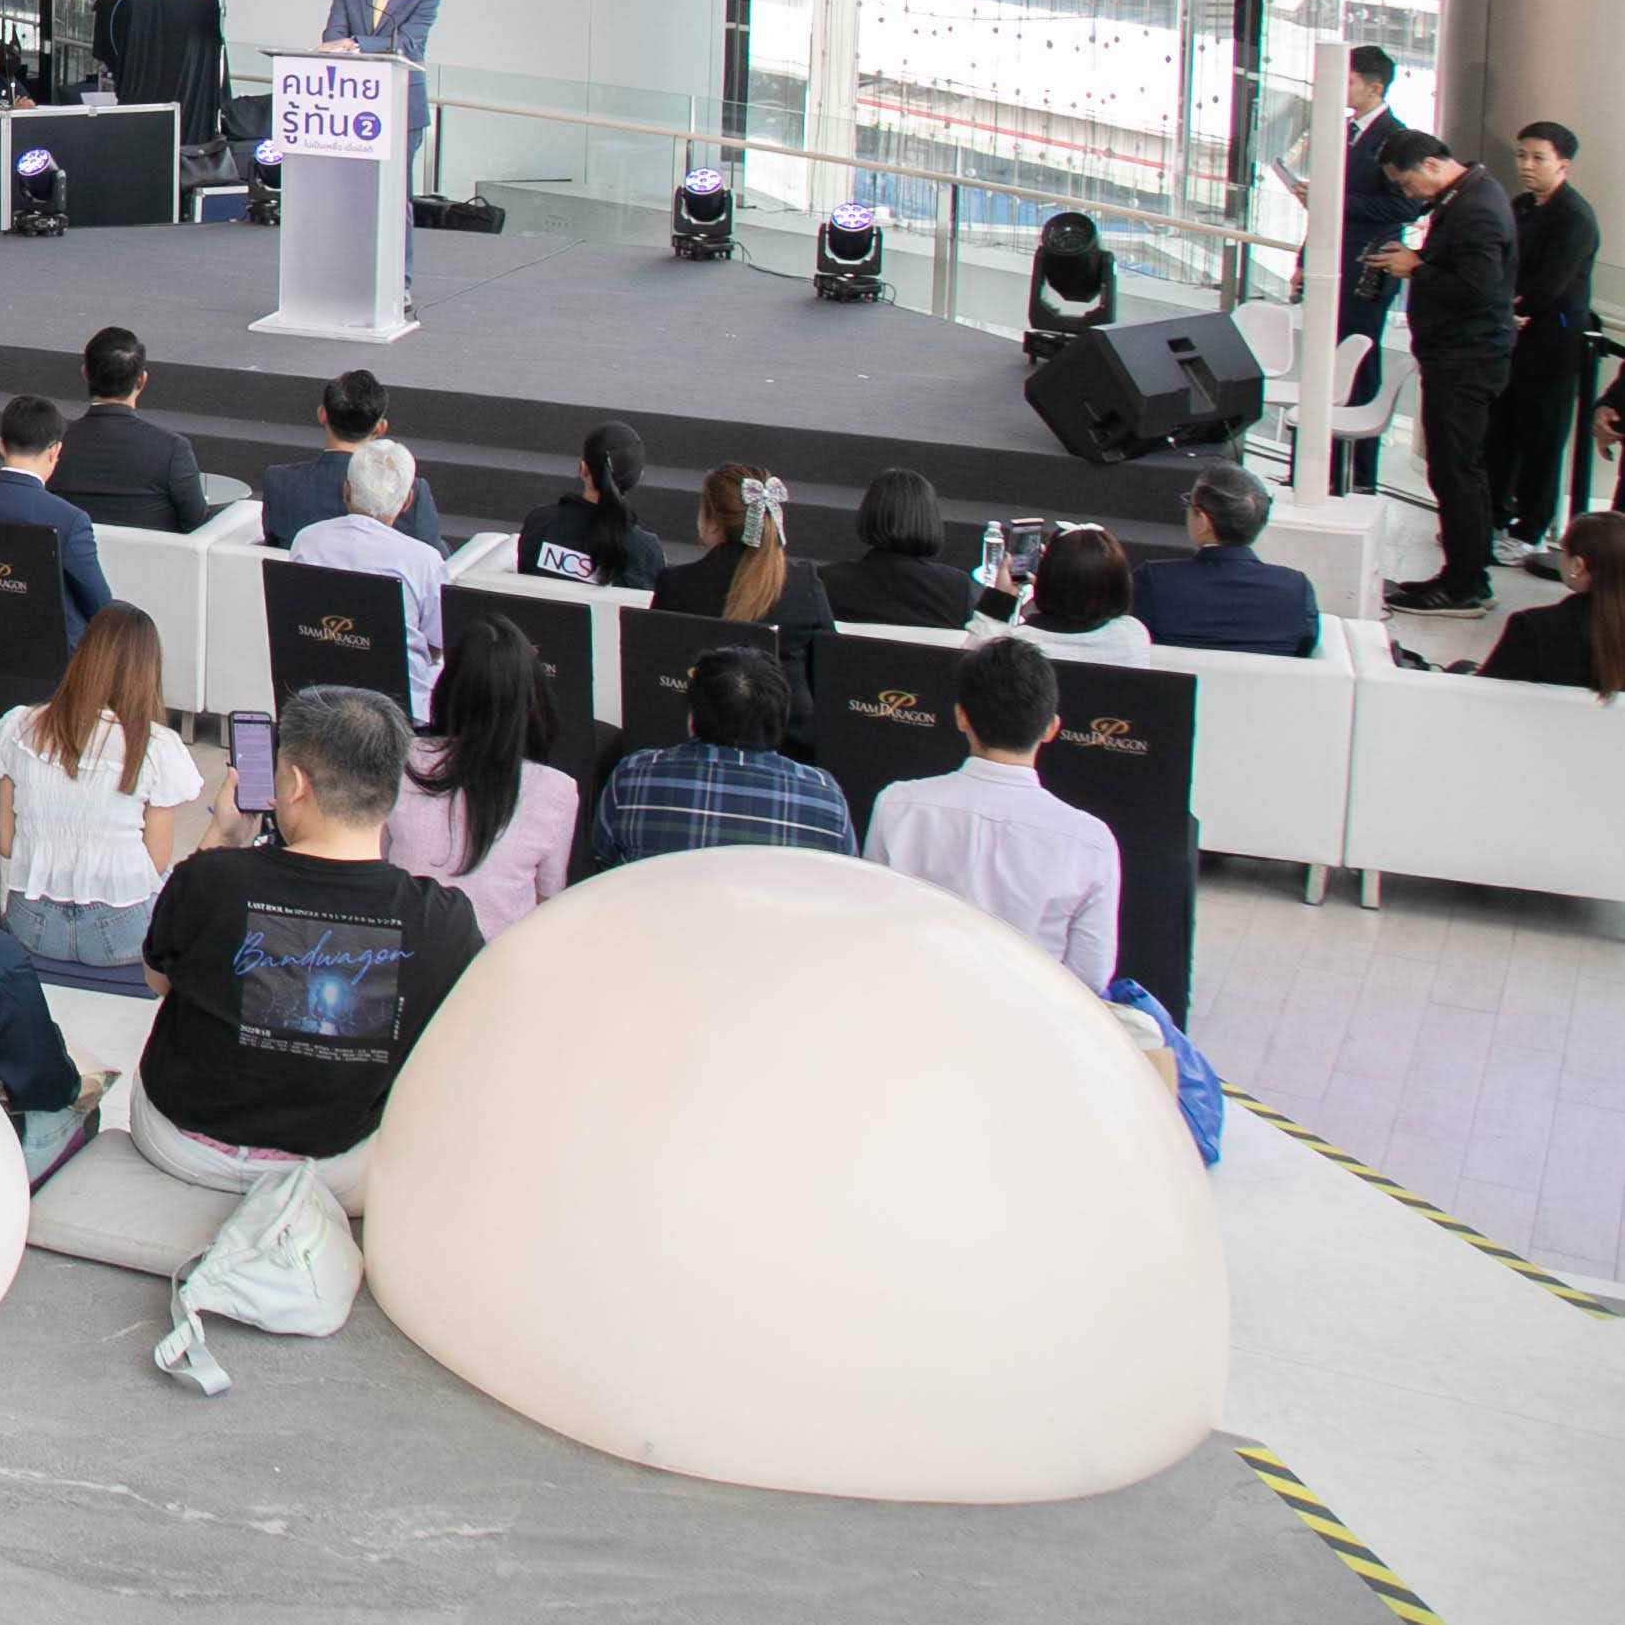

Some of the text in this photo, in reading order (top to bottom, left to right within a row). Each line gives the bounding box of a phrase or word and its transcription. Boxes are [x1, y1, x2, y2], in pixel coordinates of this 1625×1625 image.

[282, 101, 348, 144] รู้ทัน
[361, 120, 373, 136] 2
[544, 547, 594, 578] NCS
[659, 675, 689, 690] SIAM
[849, 698, 879, 716] SIAM
[1060, 728, 1091, 744] SIAM
[233, 929, 415, 986] Bandwagon
